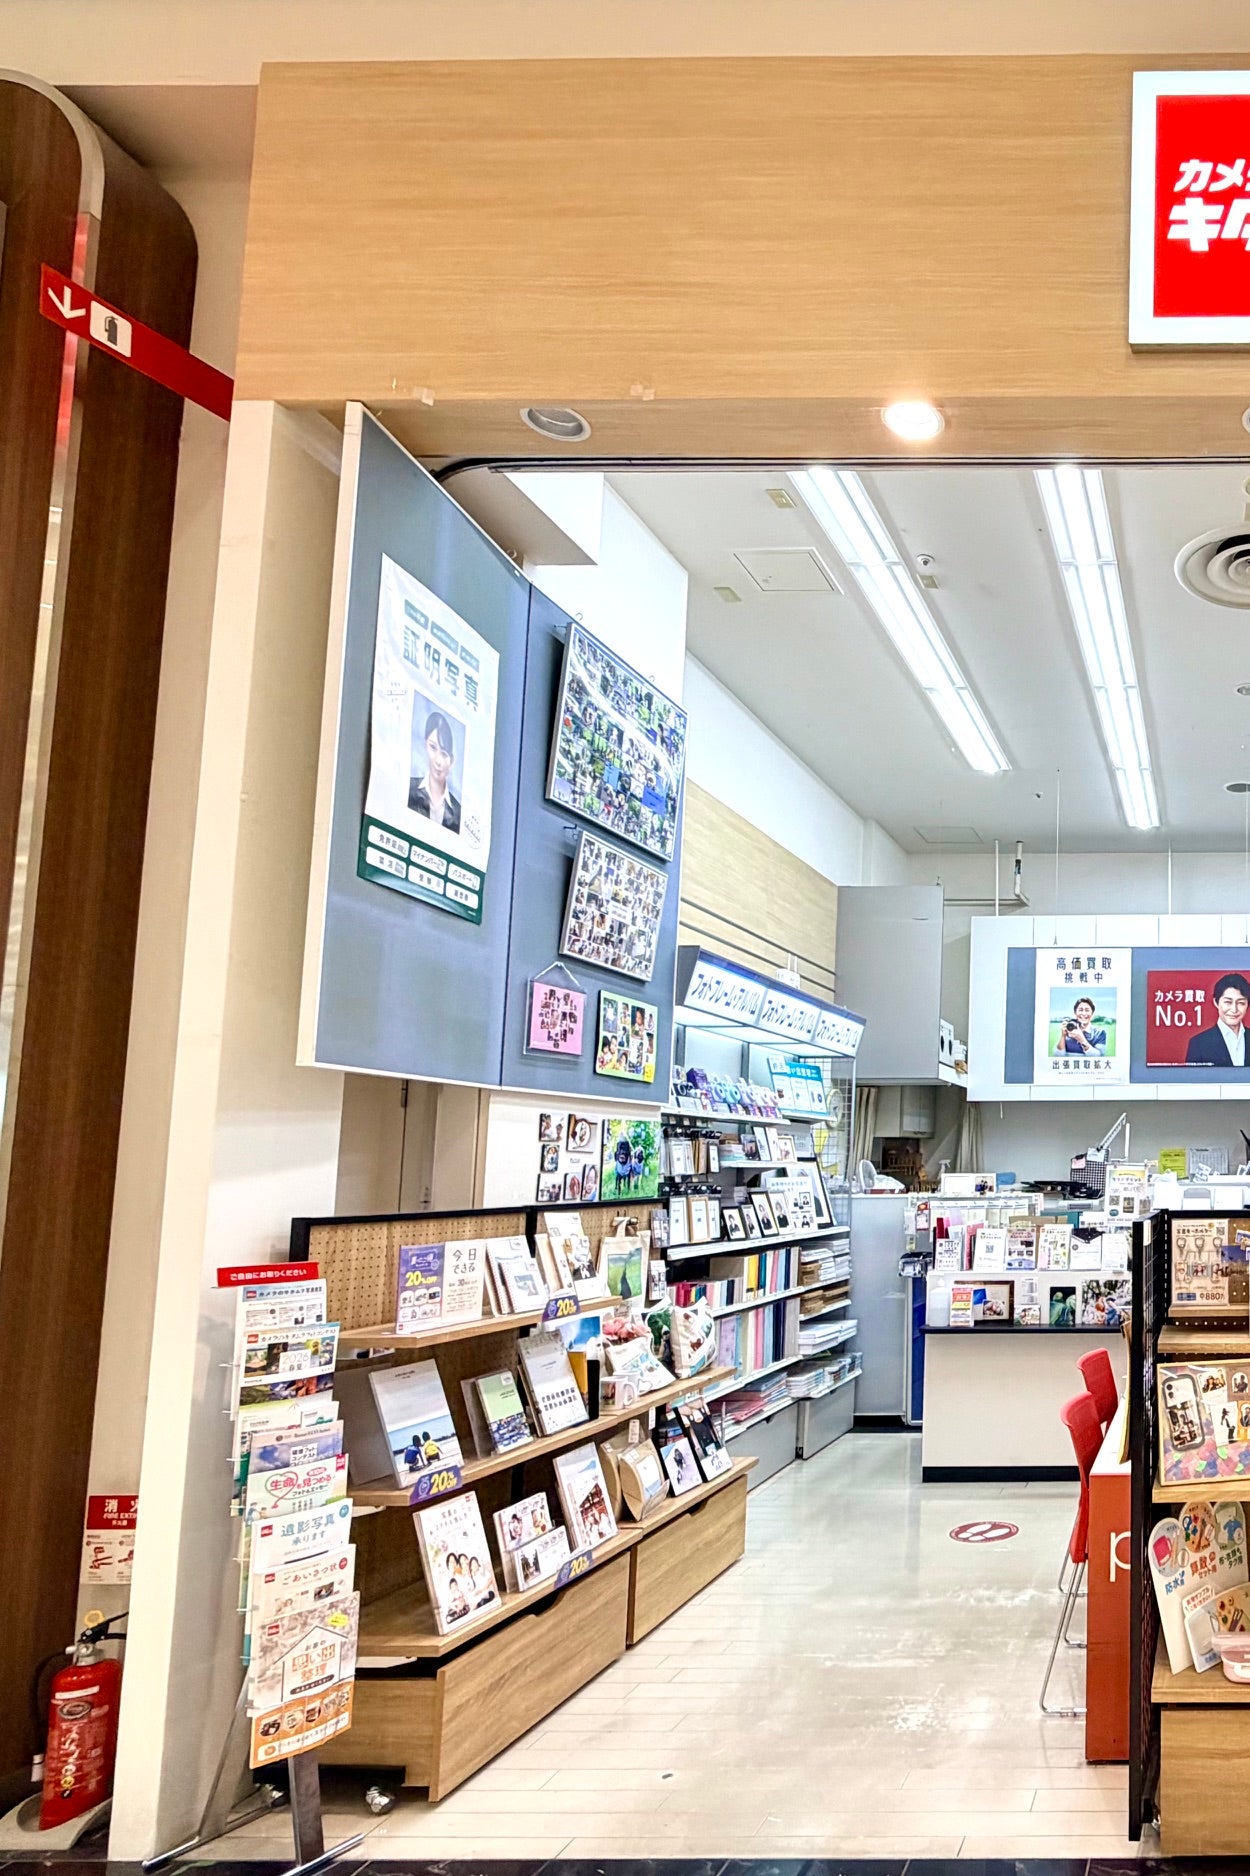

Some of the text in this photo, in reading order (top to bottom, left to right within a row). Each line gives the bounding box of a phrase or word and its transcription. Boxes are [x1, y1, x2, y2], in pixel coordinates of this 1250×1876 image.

[403, 624, 479, 713] 証明写真
[1056, 956, 1112, 970] 高価買取
[1064, 972, 1103, 983] 挑戦中
[1154, 990, 1205, 1003] カメラ買取
[1155, 1005, 1202, 1027] No.1
[1052, 1059, 1112, 1070] 出張買取拡大
[452, 1248, 477, 1262] 今日
[230, 1269, 307, 1281] ご自由にお取りください
[452, 1262, 476, 1275] できる
[281, 1513, 335, 1537] 遺影写真
